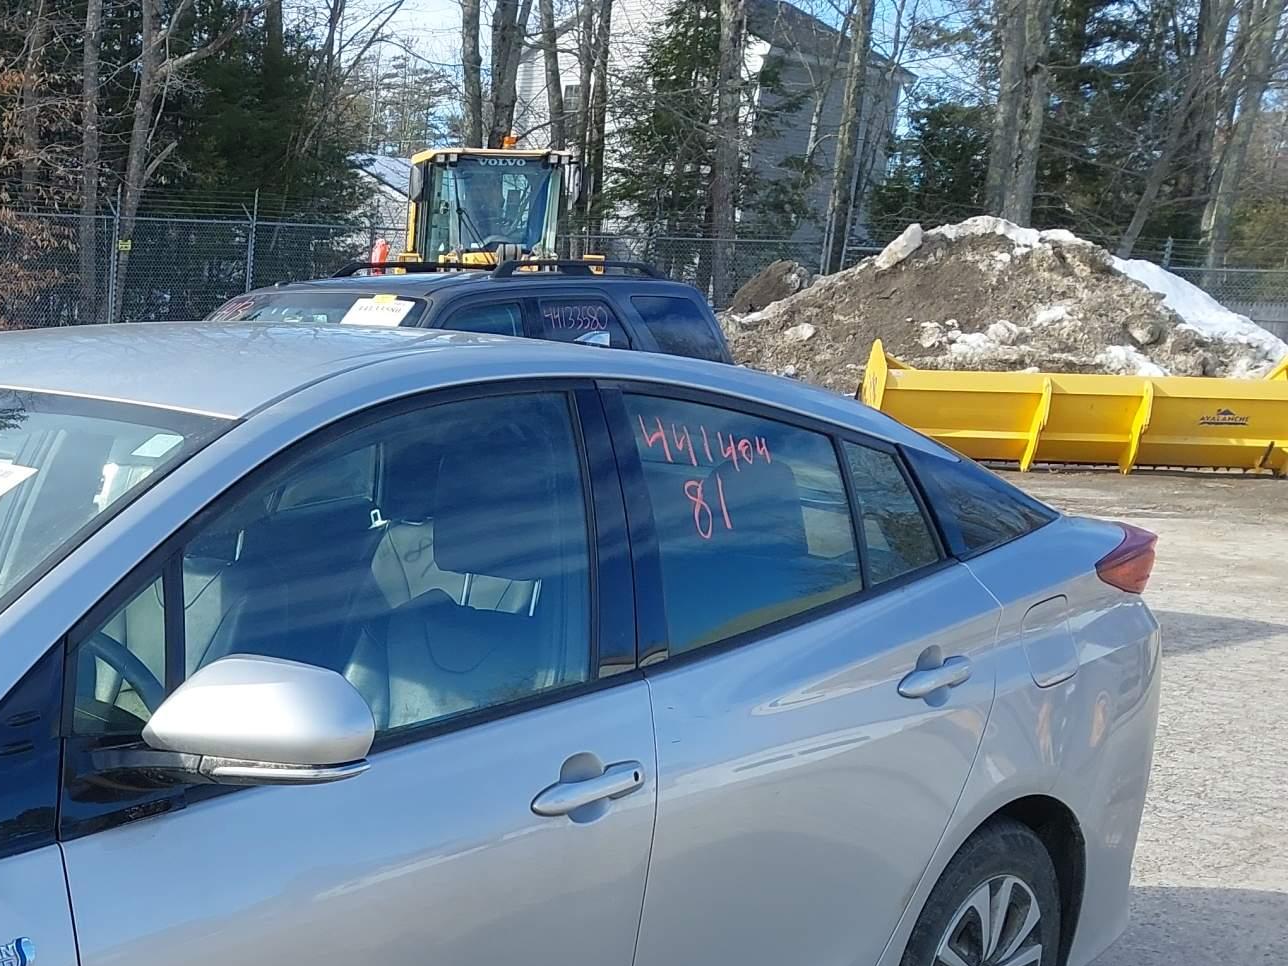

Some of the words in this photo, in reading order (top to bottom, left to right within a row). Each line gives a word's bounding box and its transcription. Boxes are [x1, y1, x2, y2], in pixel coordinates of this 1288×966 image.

[478, 158, 527, 167] VOLVO
[543, 305, 608, 330] 44133580
[638, 414, 772, 472] 441404
[684, 473, 733, 539] 81
